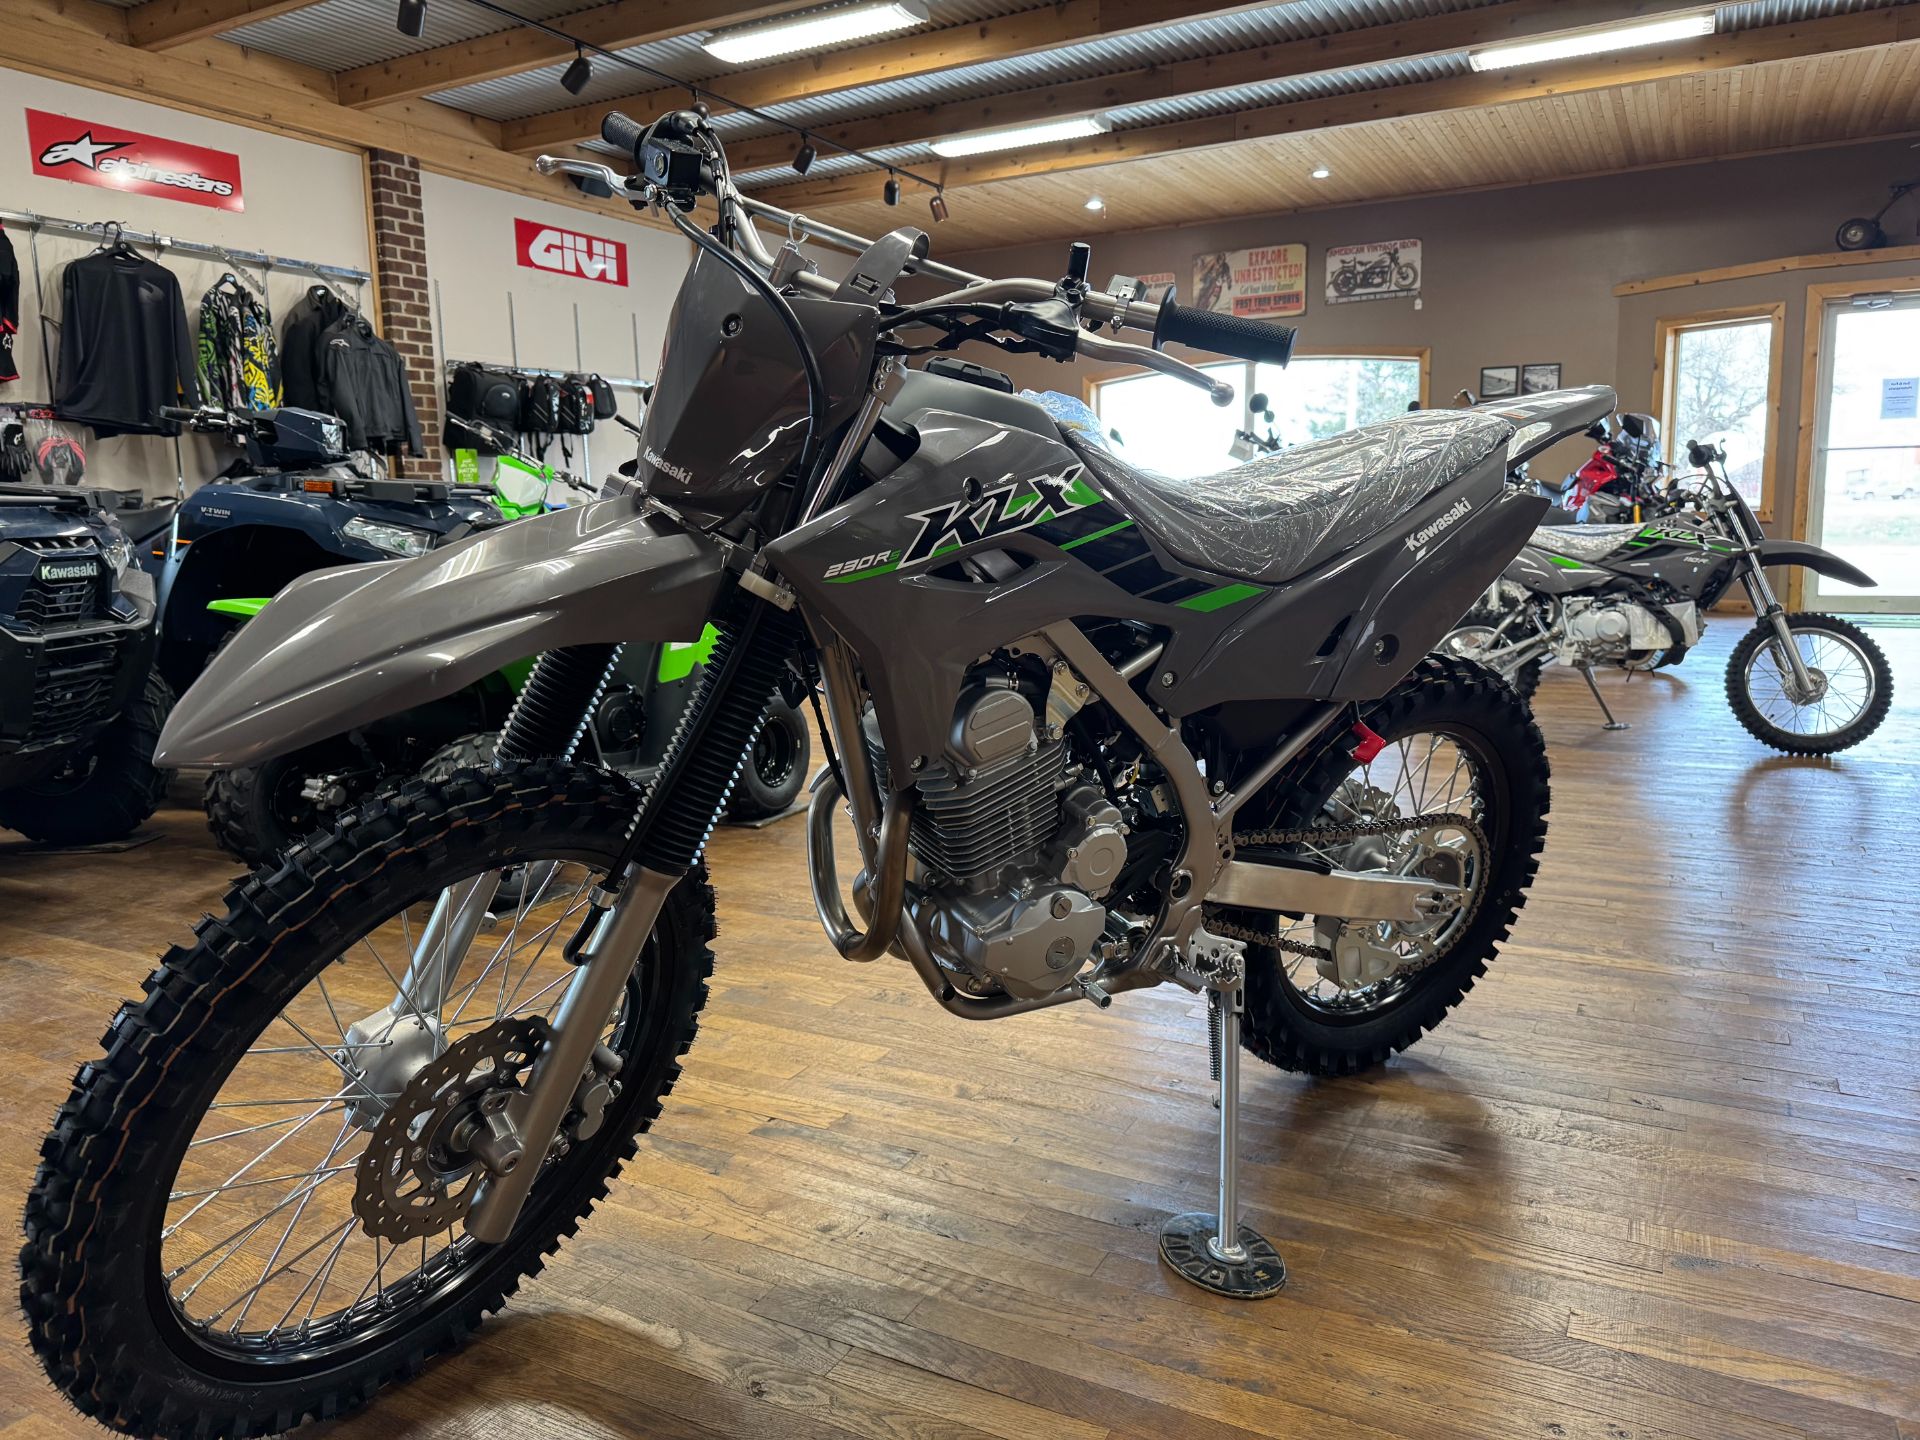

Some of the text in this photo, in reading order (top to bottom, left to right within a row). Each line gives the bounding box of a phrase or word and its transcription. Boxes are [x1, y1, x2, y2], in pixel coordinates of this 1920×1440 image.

[528, 229, 618, 282] GIVI
[1248, 248, 1289, 268] EXPLORE
[1329, 246, 1365, 258] AMERICAN
[1400, 240, 1418, 250] IRON
[1234, 263, 1303, 284] UNRESTRICTED!
[1273, 293, 1300, 306] SPORTS
[643, 446, 693, 485] Kawasaki
[897, 463, 1085, 569] KLX
[1405, 497, 1472, 551] Kawasaki
[41, 562, 97, 580] Kawasaki
